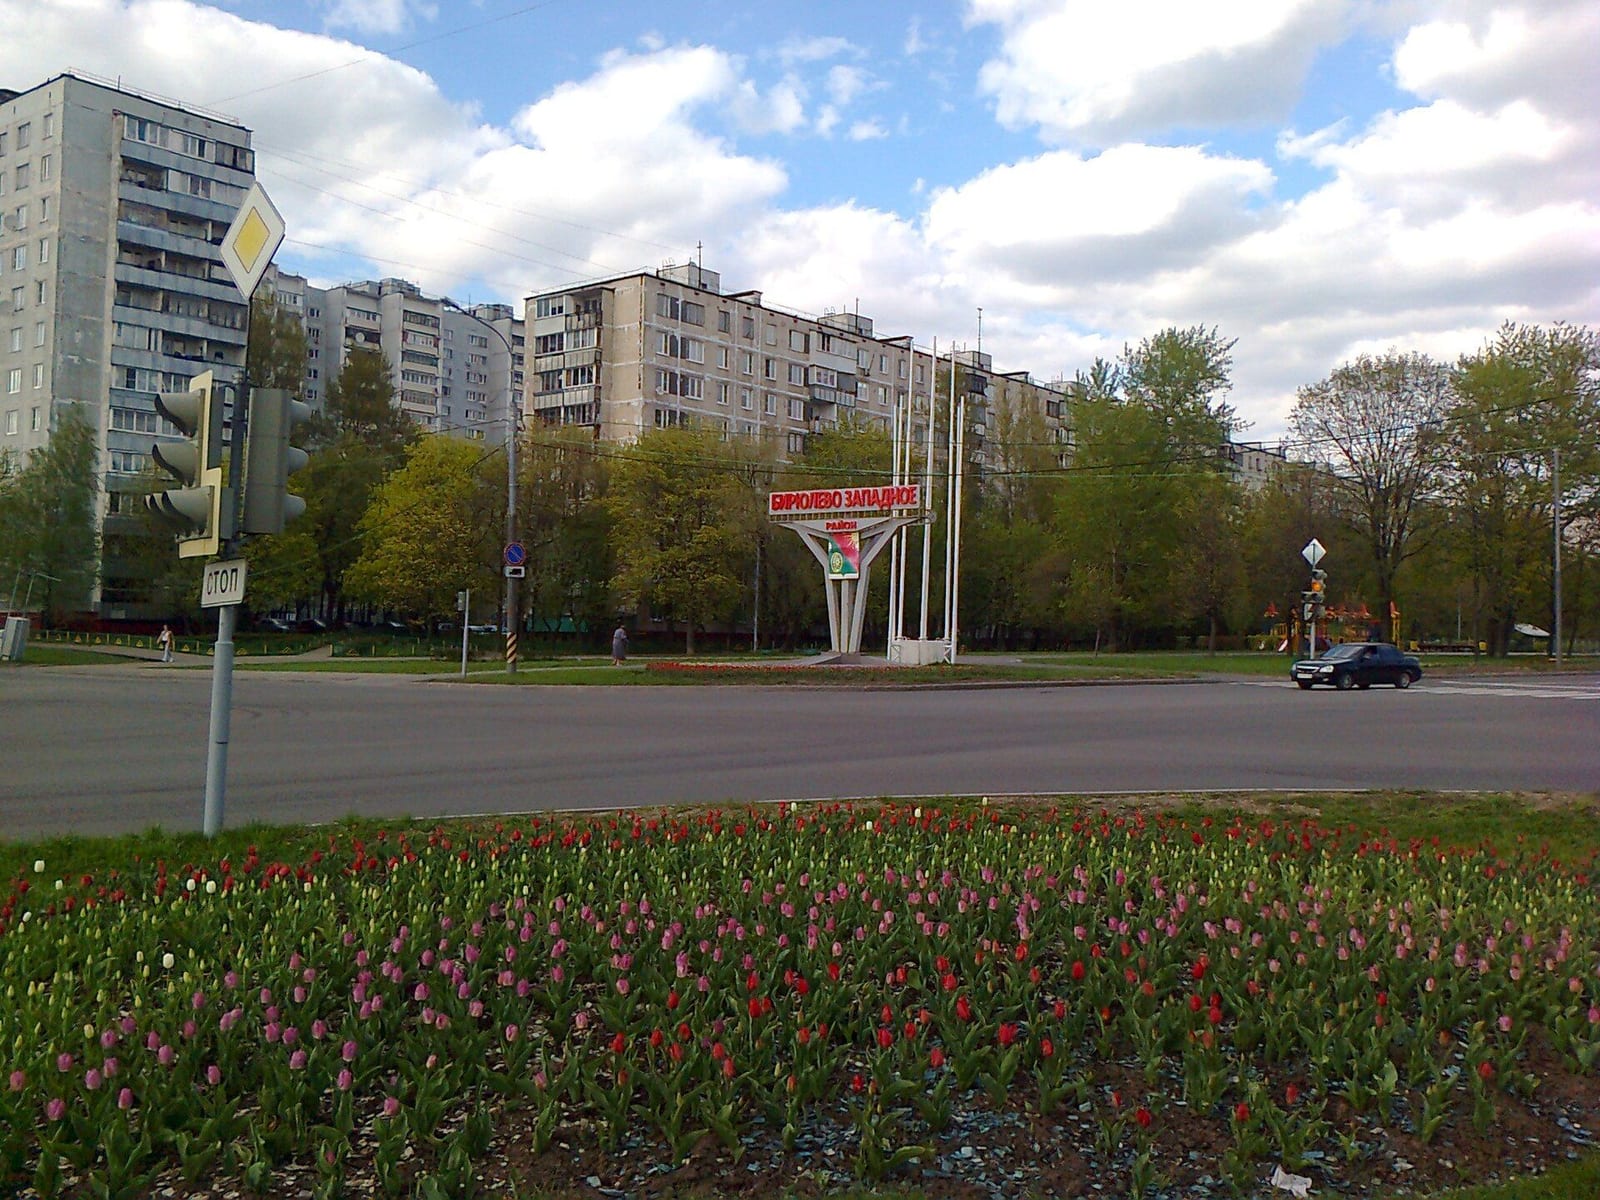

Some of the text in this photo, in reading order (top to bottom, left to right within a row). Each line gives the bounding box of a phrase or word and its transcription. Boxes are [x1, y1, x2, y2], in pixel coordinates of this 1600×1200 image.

[771, 486, 917, 511] БИРЮЛЕВО ЗАПАДНОЕ
[826, 519, 857, 531] РАЙОН
[207, 568, 238, 595] СТОП
